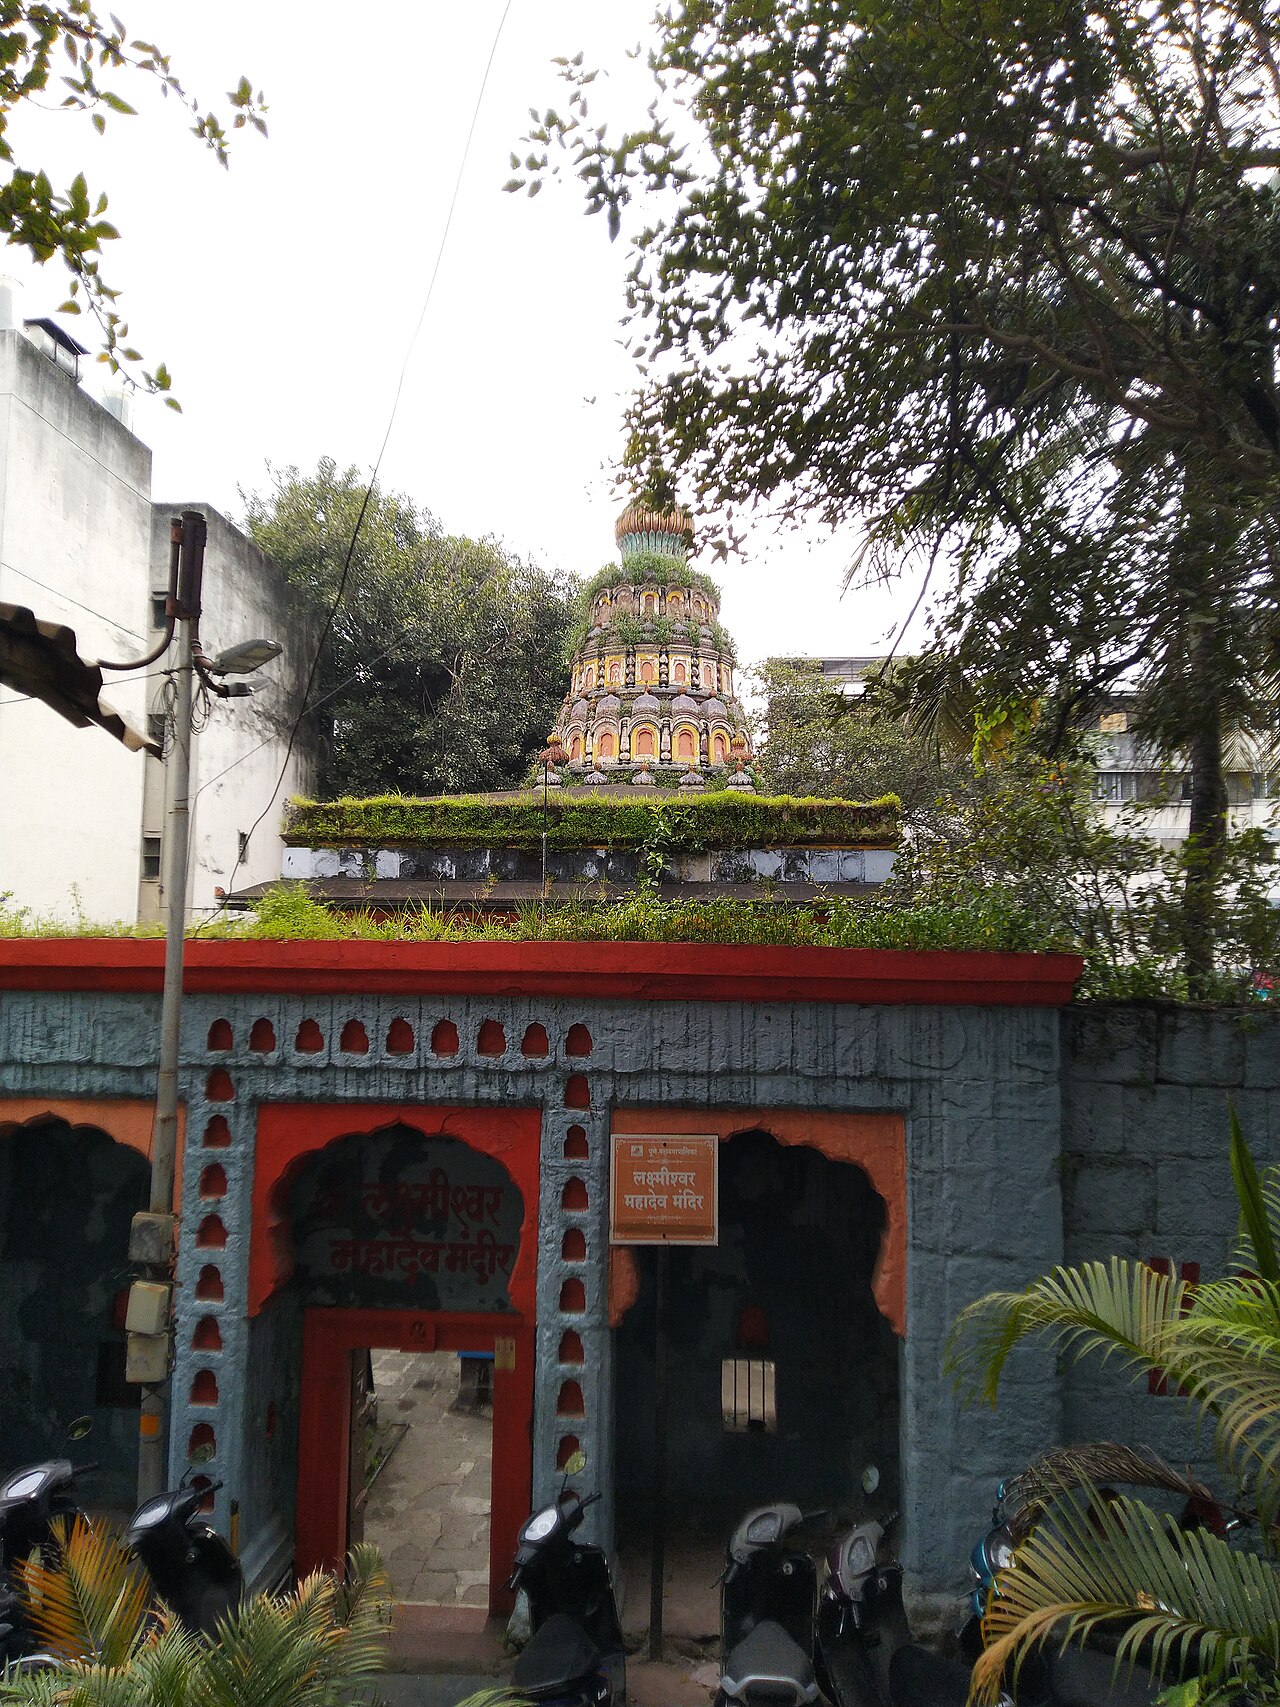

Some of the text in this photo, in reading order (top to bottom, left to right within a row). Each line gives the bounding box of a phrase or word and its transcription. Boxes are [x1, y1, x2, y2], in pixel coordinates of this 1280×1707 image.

[632, 1166, 697, 1188] लक्ष्मीश्वर
[624, 1189, 705, 1211] महादेव मंदिर
